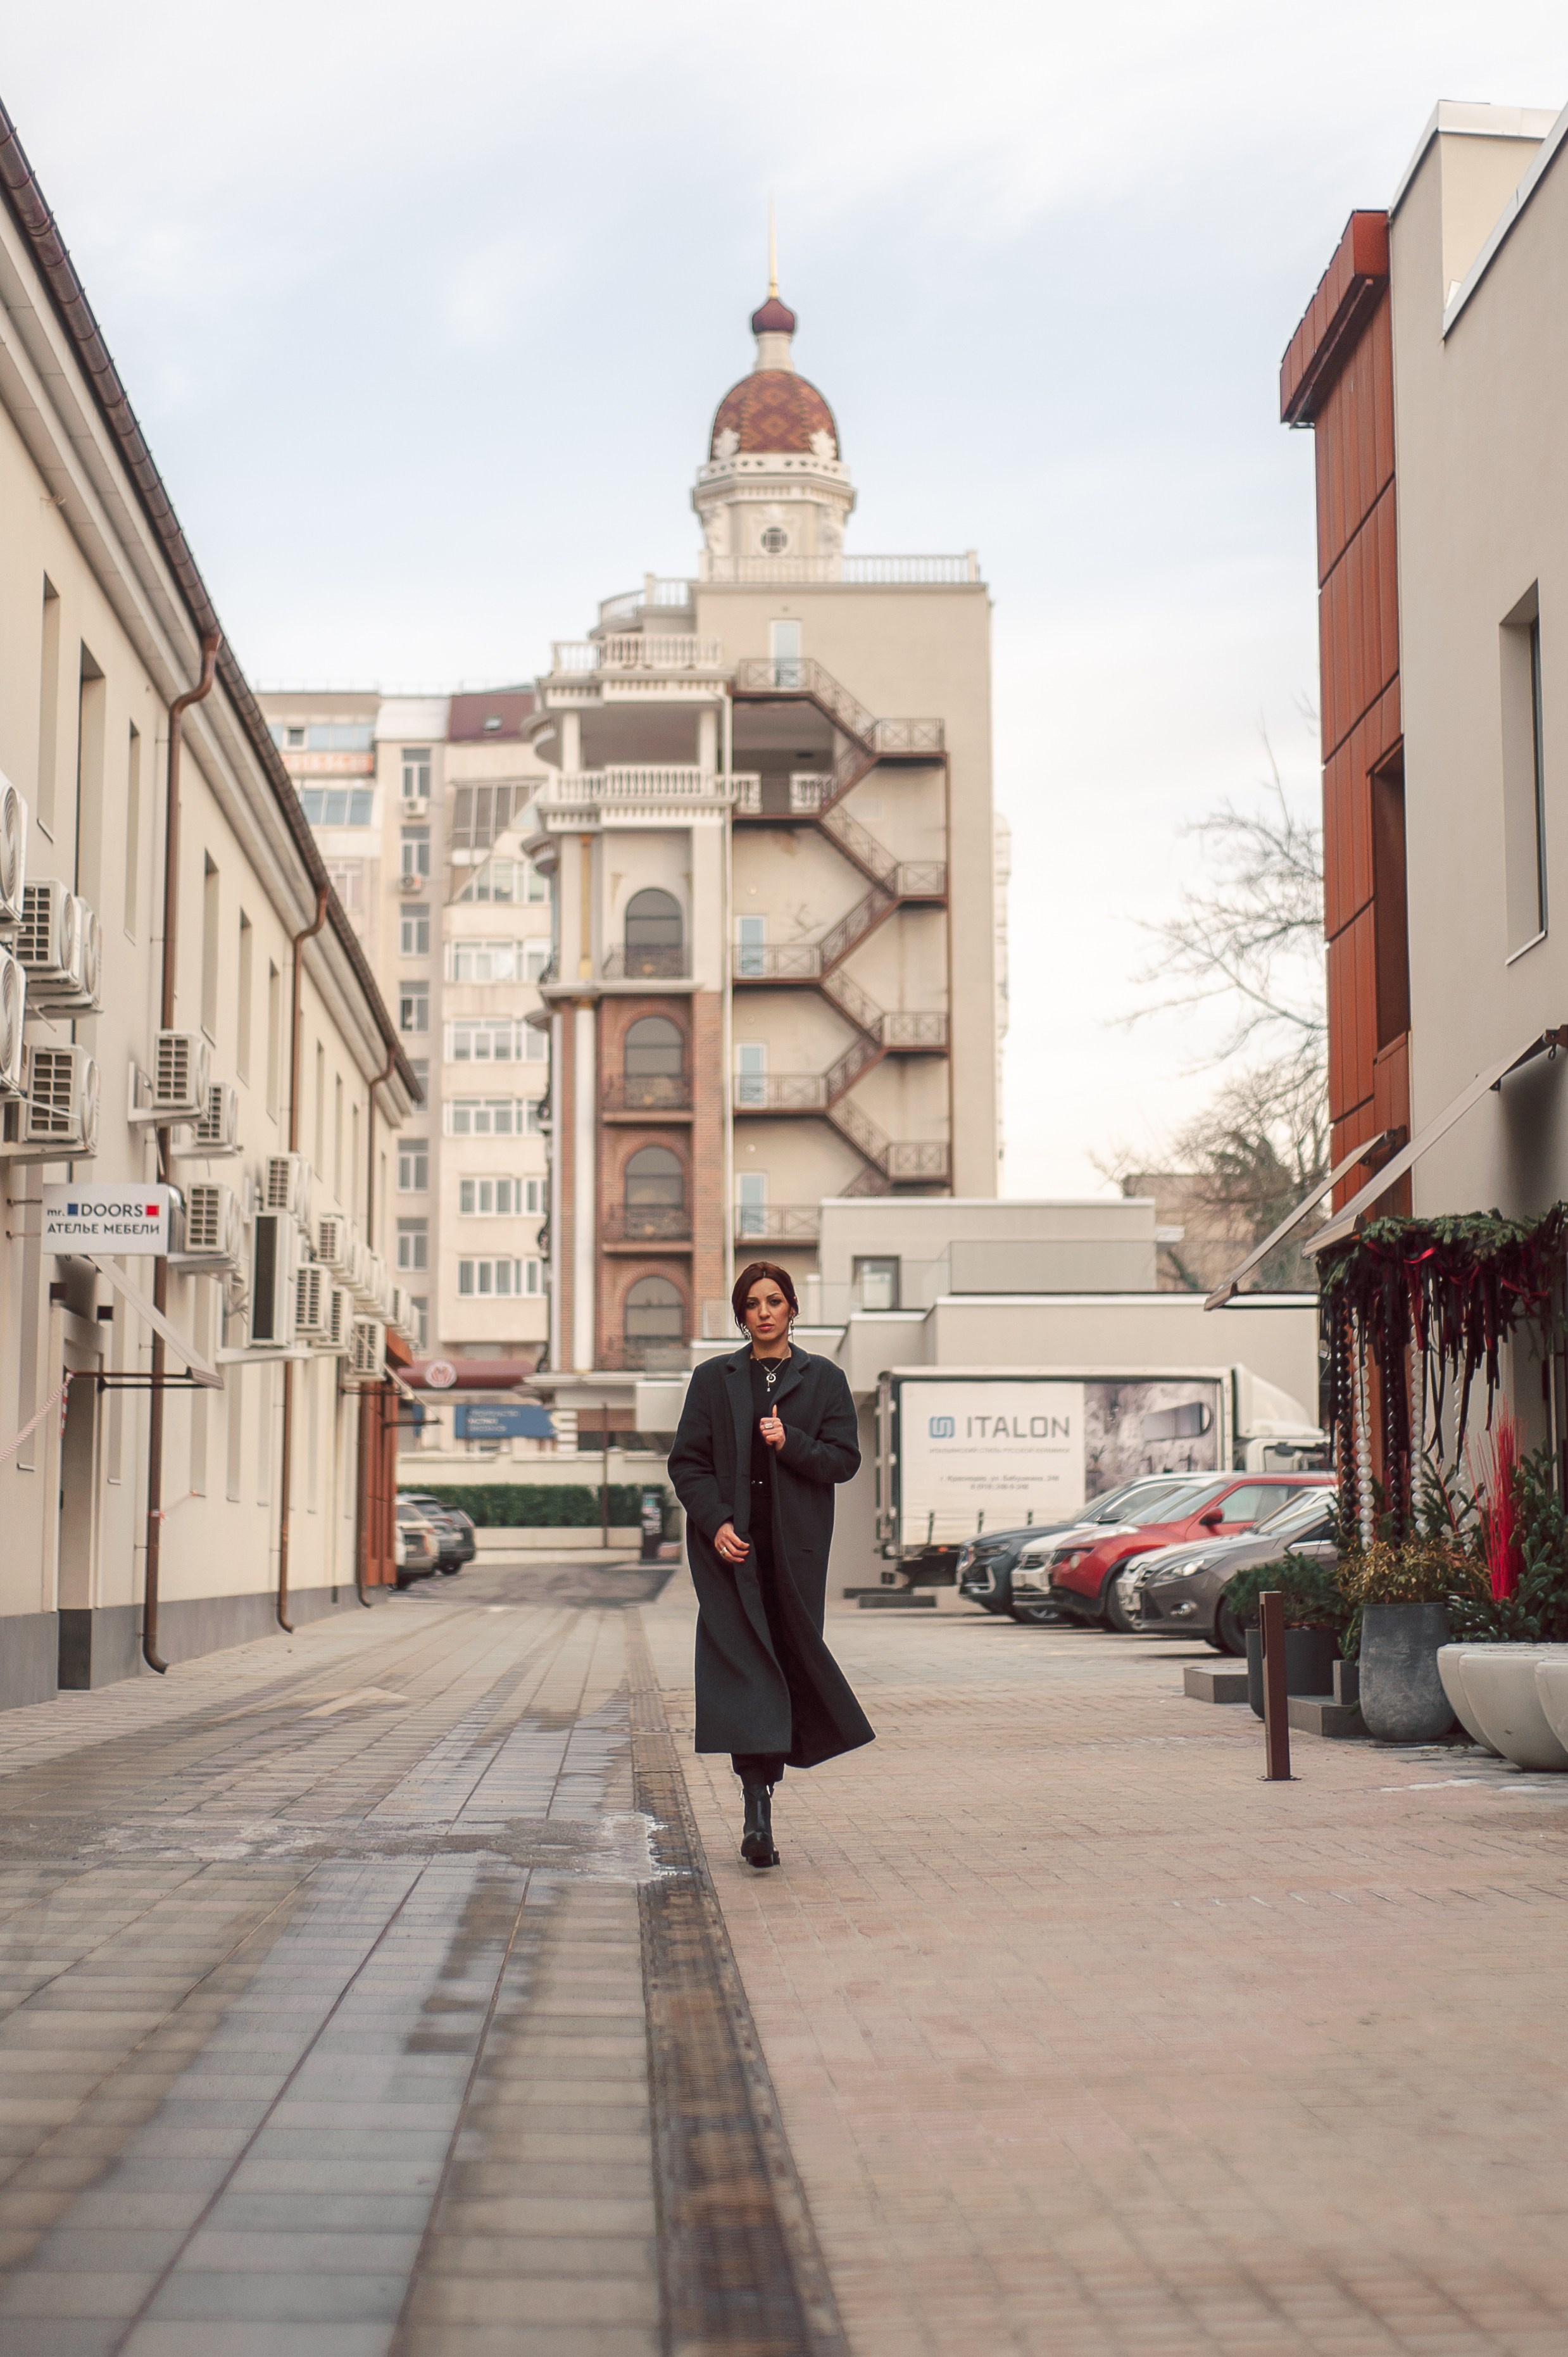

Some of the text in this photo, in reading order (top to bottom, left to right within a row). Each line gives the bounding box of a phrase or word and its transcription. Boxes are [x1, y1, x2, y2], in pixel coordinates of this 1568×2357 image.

[47, 1204, 143, 1217] mr. DOORS
[47, 1222, 160, 1235] АТЕЛЬЕ МЕБЕЛИ
[967, 1416, 1070, 1438] ITALON
